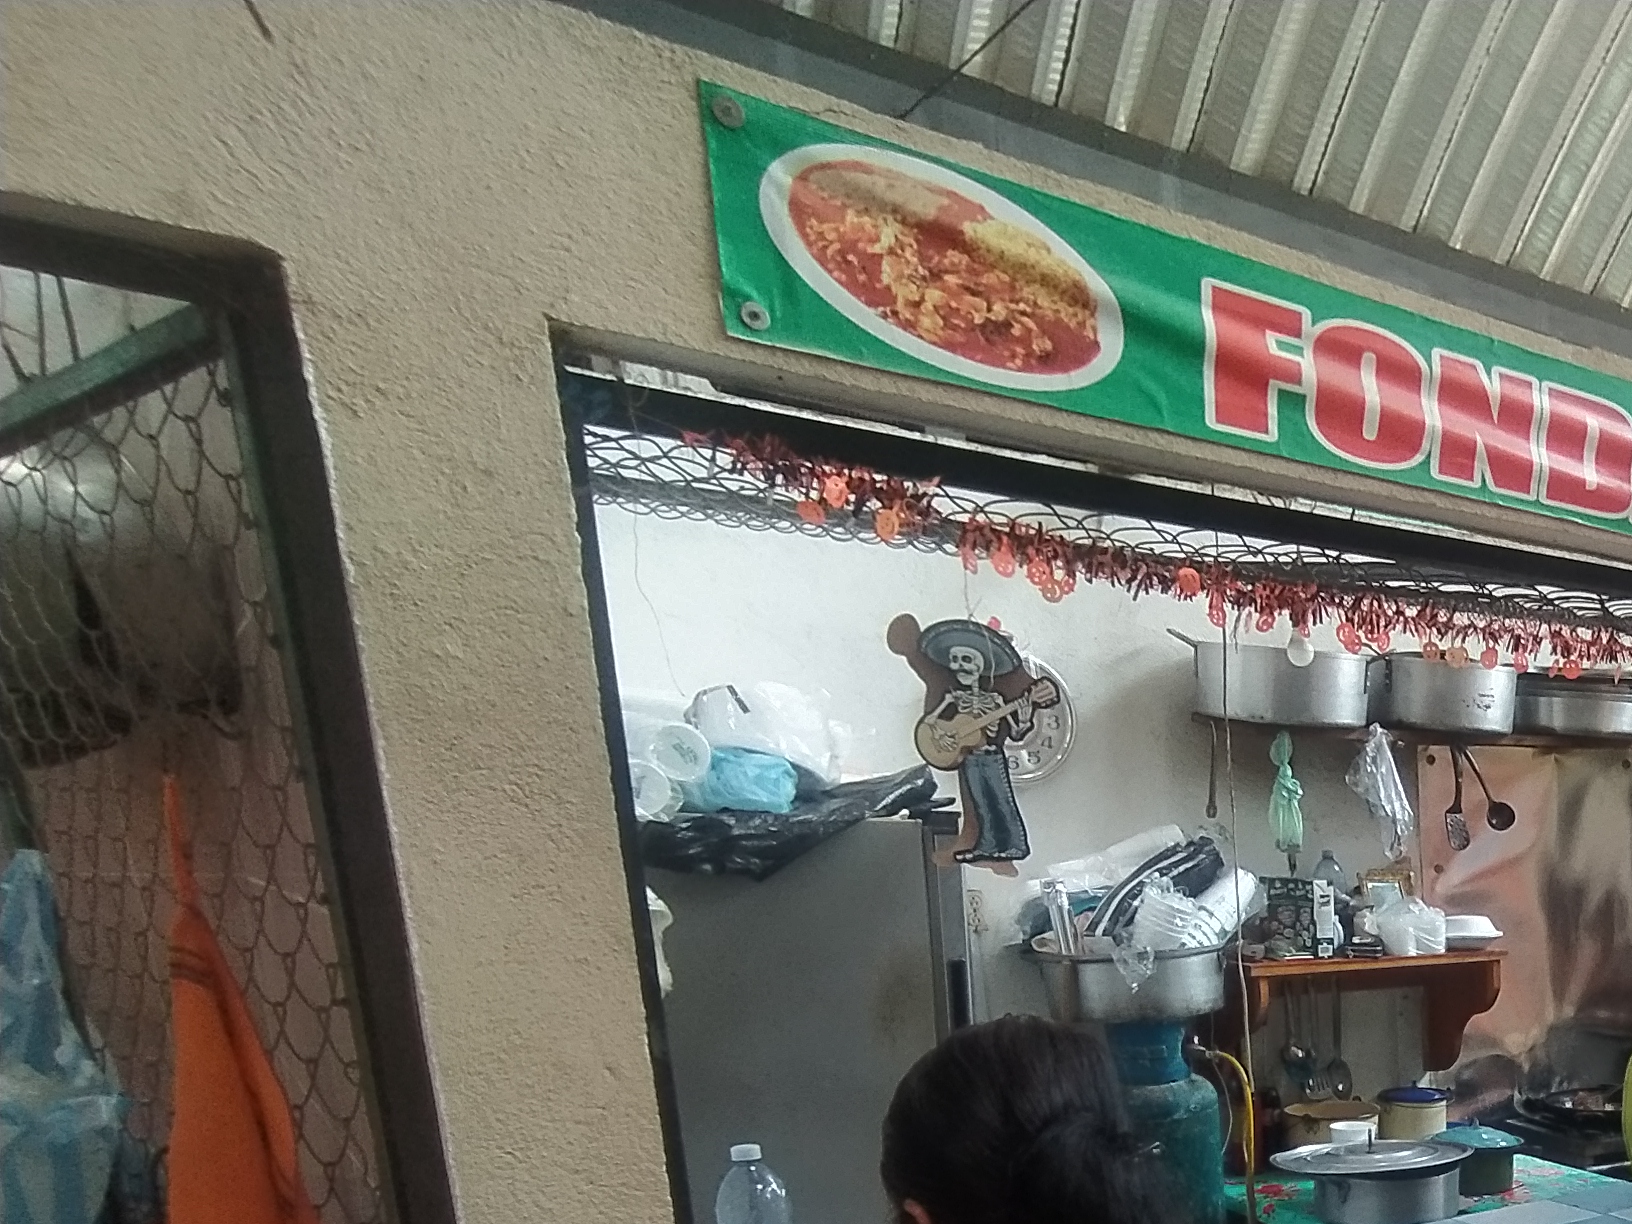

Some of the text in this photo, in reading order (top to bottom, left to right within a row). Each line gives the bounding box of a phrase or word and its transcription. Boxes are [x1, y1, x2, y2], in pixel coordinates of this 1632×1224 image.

[1047, 715, 1060, 730] 3
[1041, 736, 1053, 749] 4
[1008, 755, 1020, 770] 6
[1027, 750, 1041, 765] 5
